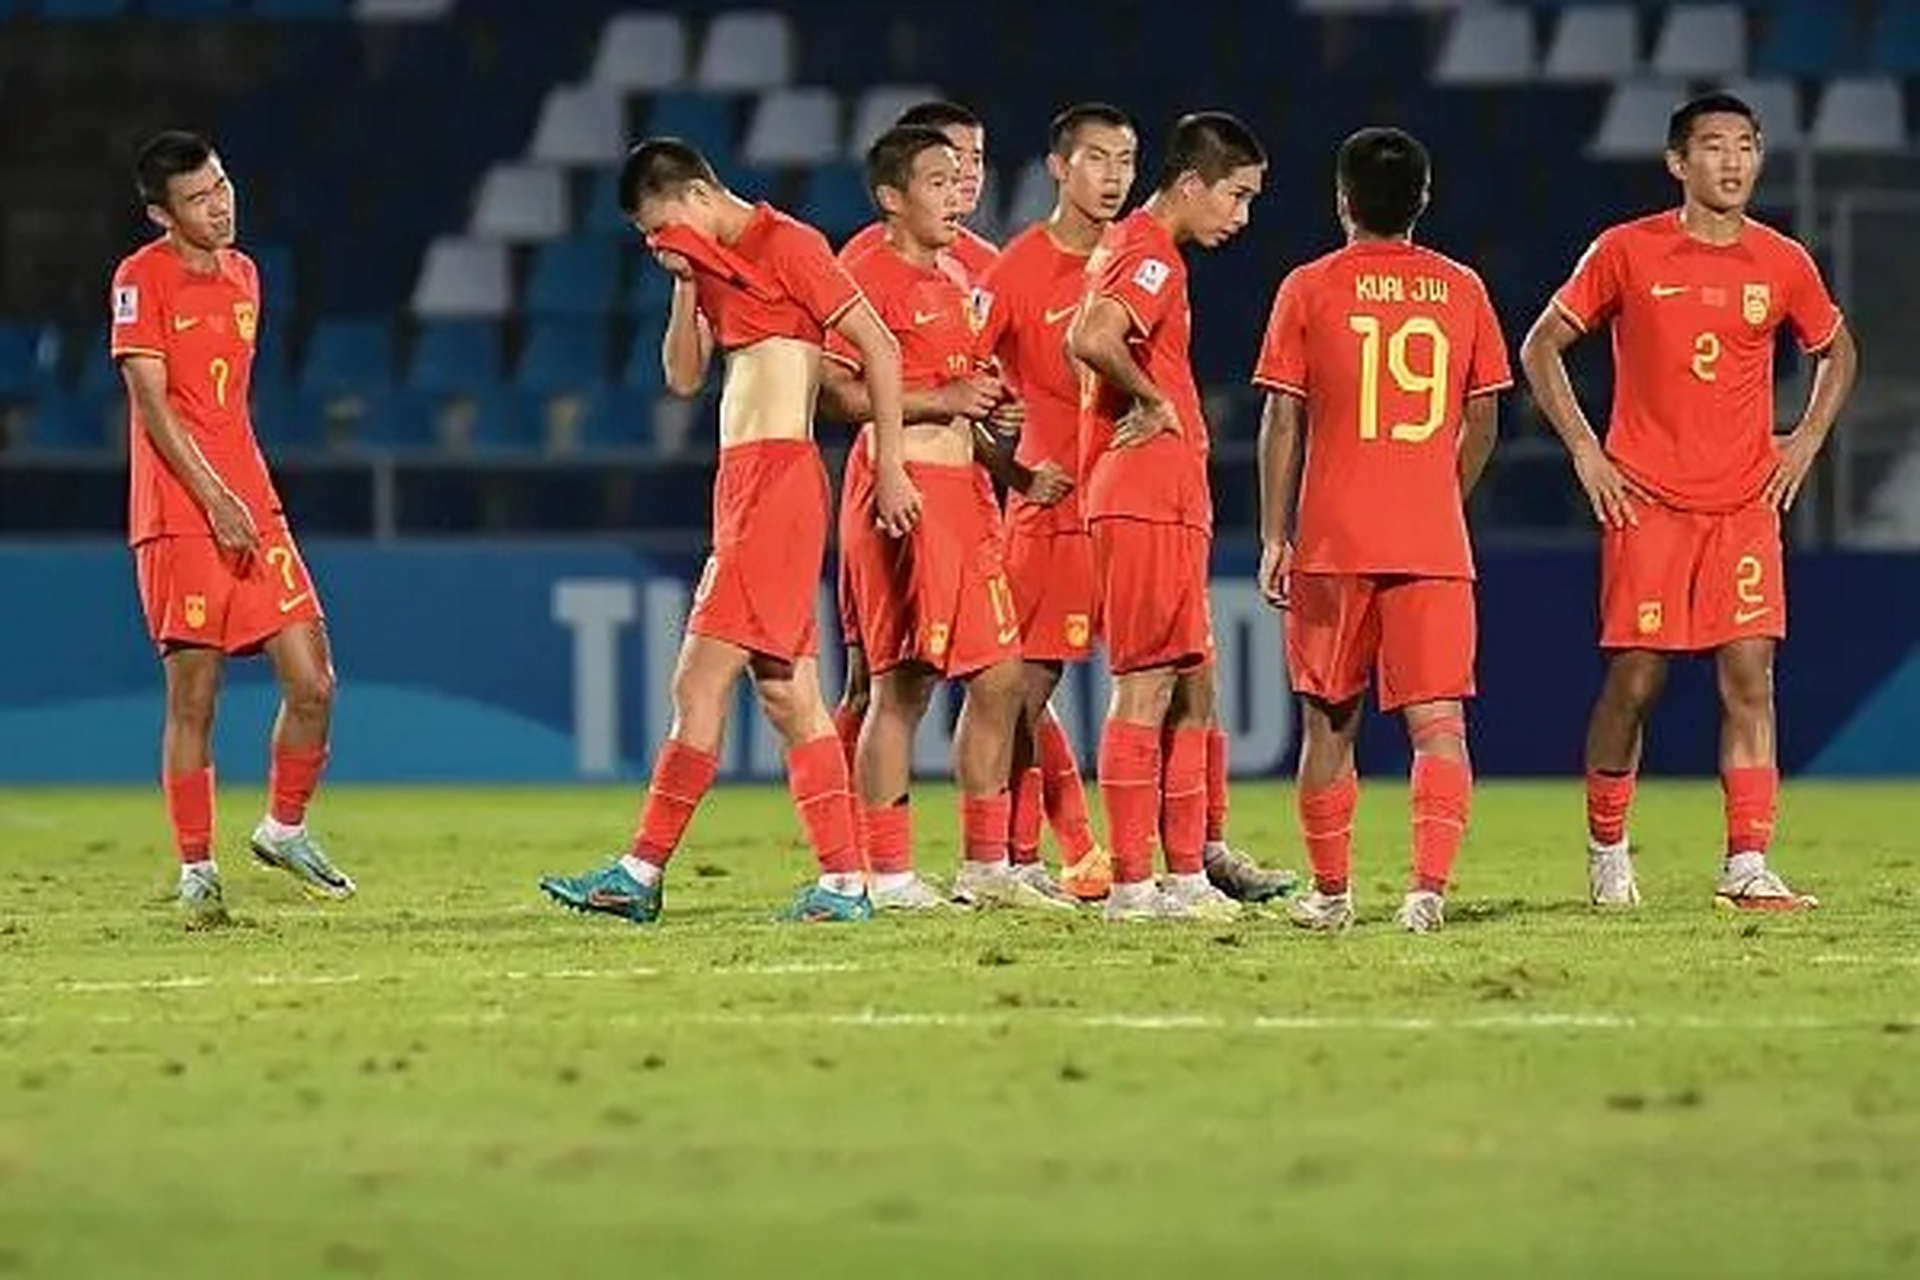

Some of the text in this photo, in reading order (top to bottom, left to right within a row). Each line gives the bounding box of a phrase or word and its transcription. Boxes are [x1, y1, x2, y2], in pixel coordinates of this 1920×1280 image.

[1411, 275, 1448, 304] JW
[1349, 315, 1449, 441] 19
[1692, 331, 1720, 381] 2
[209, 357, 229, 409] 7
[266, 545, 295, 590] 7
[1736, 556, 1764, 603] 2
